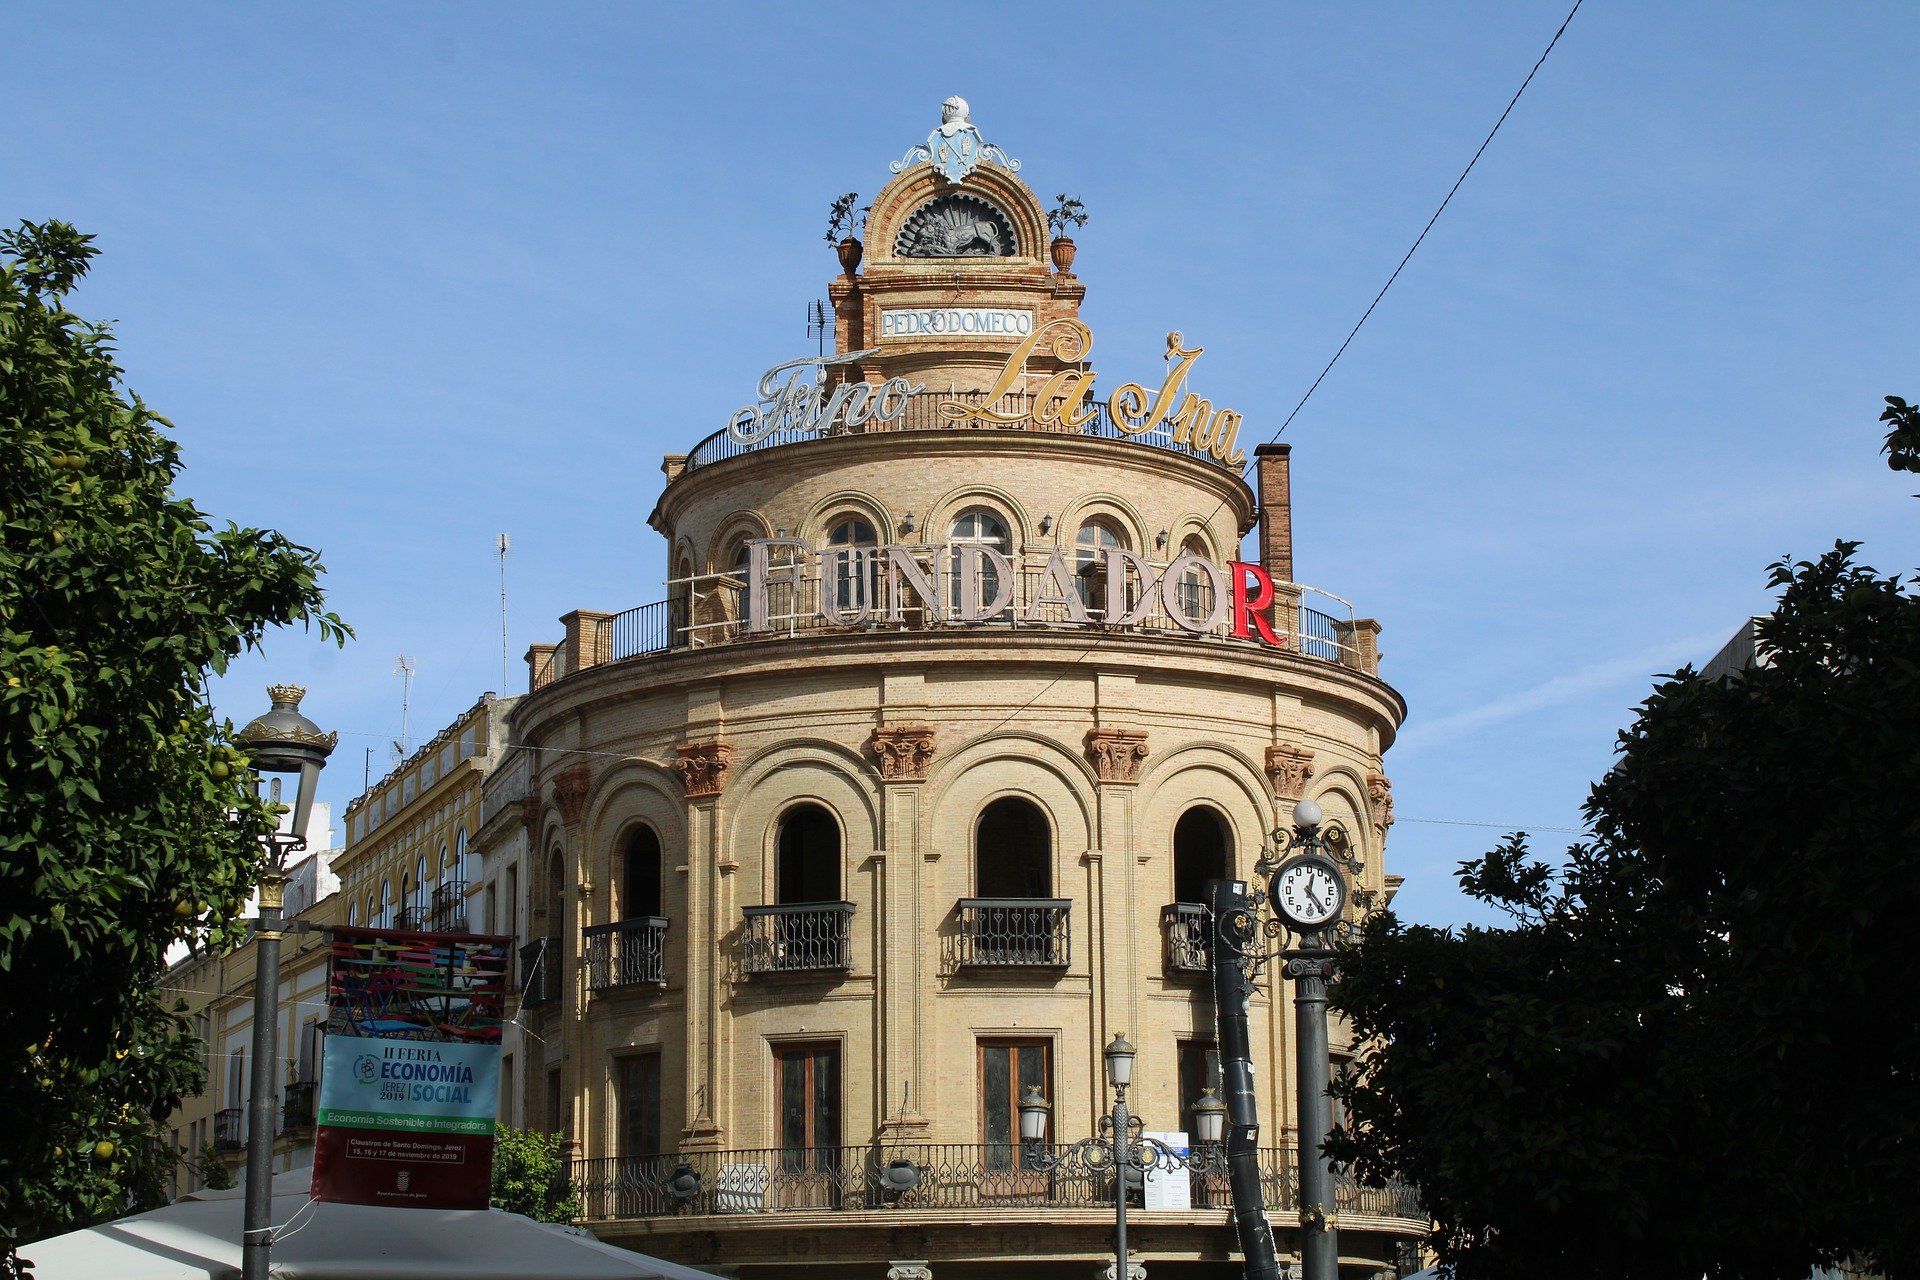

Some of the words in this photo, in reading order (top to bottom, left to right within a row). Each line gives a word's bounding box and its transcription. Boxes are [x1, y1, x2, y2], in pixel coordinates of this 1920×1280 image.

[882, 310, 947, 335] PEDRO
[948, 312, 1032, 335] DOMECQ
[727, 346, 926, 446] Fino
[937, 318, 1099, 428] La
[1108, 330, 1246, 466] Ina
[743, 537, 1287, 646] FUNDADOR
[384, 1047, 393, 1060] II
[398, 1047, 442, 1063] FERIA
[381, 1061, 474, 1084] ECONOMÍA
[379, 1091, 405, 1101] 2019
[381, 1082, 406, 1093] JEREZ
[412, 1083, 472, 1104] SOCIAL
[327, 1112, 375, 1125] Economía
[376, 1116, 424, 1128] Sostenible
[434, 1120, 487, 1131] Integradora
[350, 1138, 382, 1147] Claustros
[397, 1151, 430, 1159] noviembre
